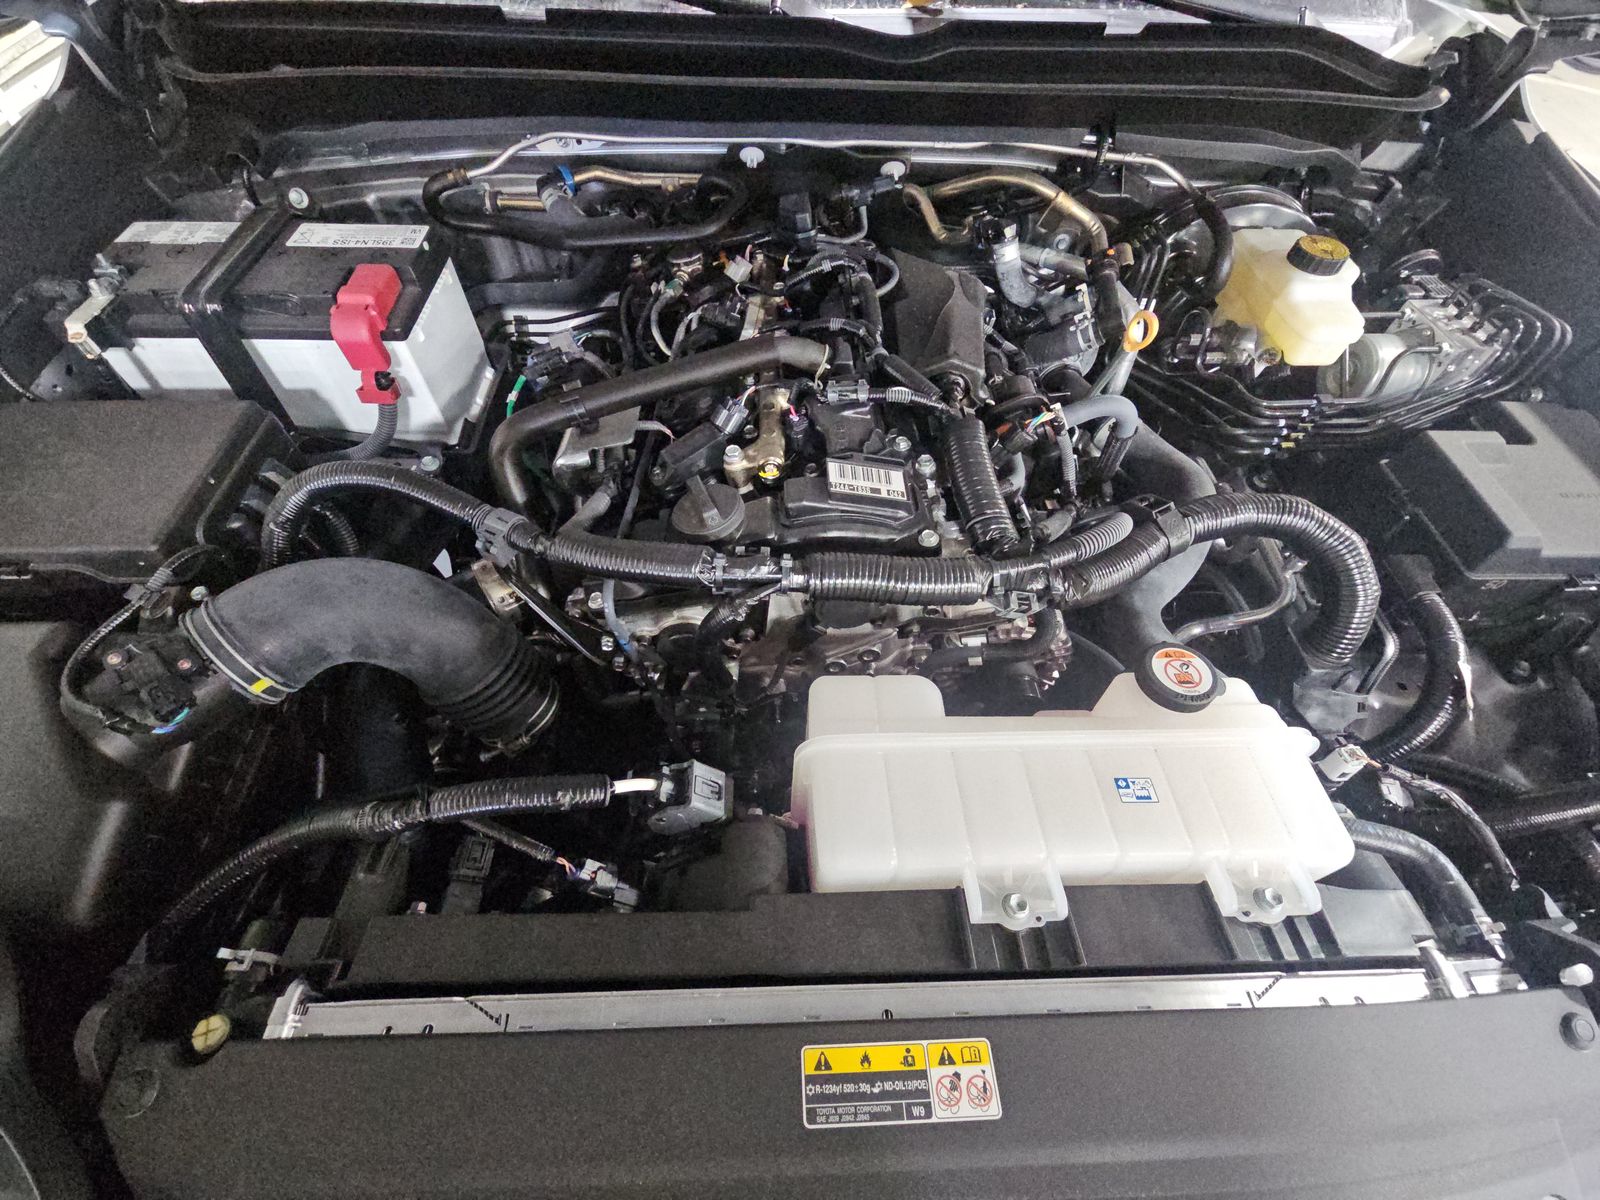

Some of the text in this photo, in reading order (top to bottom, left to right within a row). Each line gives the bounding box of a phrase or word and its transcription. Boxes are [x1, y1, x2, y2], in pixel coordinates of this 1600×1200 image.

[815, 1079, 929, 1095] R-1234yf 520±30g ND-OIL12(POE)
[816, 1104, 892, 1115] TOYOTA MOTOR CORPORATION
[911, 1106, 925, 1117] W9
[816, 1115, 827, 1123] SAE
